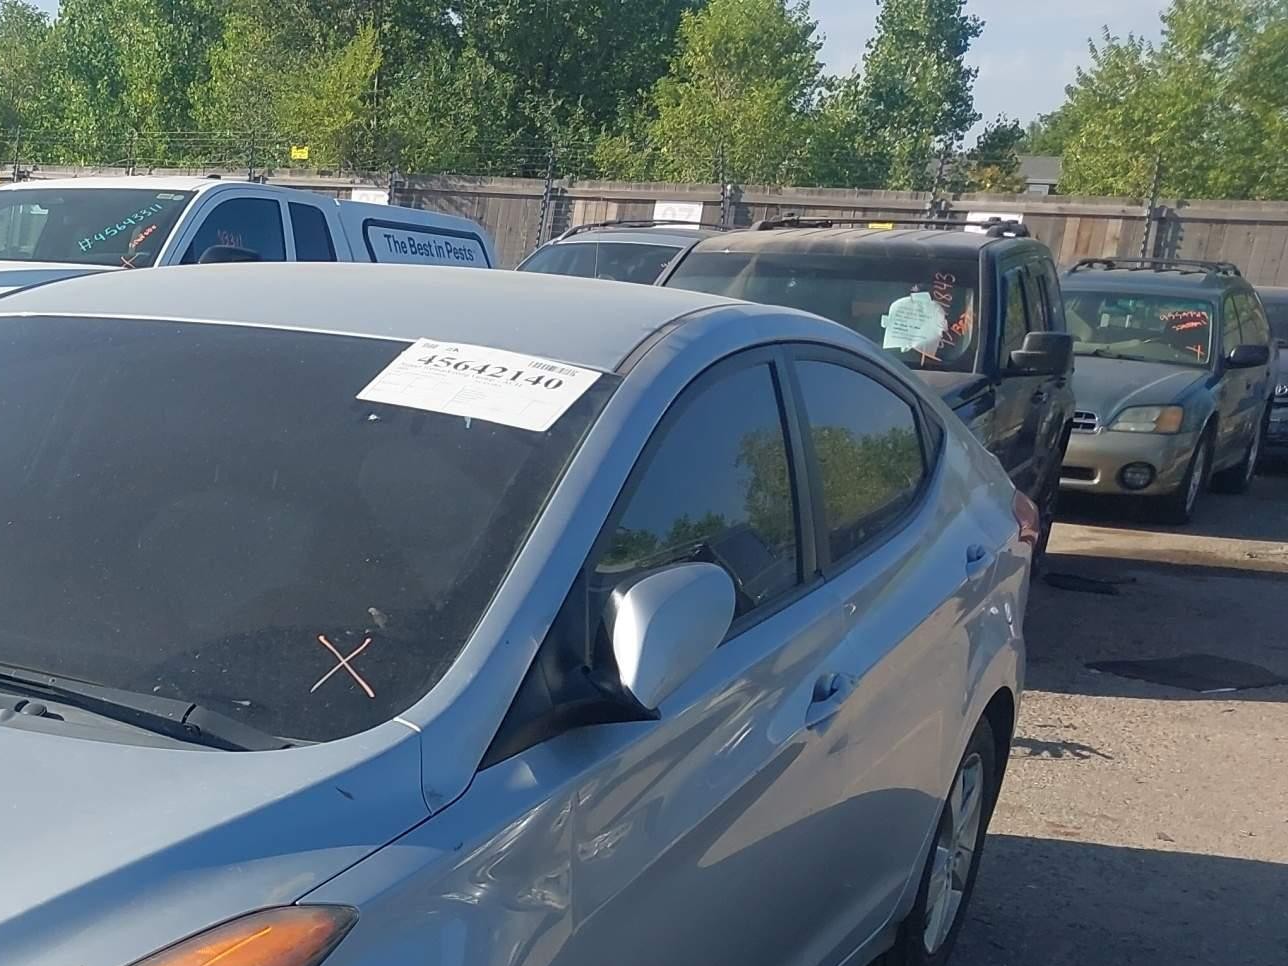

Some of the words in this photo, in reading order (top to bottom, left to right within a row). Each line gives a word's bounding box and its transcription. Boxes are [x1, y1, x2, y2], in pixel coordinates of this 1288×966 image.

[78, 203, 163, 252] #45643311
[384, 233, 407, 254] The
[408, 236, 433, 257] Best
[433, 240, 446, 258] in
[445, 241, 474, 261] Pests
[417, 354, 563, 390] 45642140
